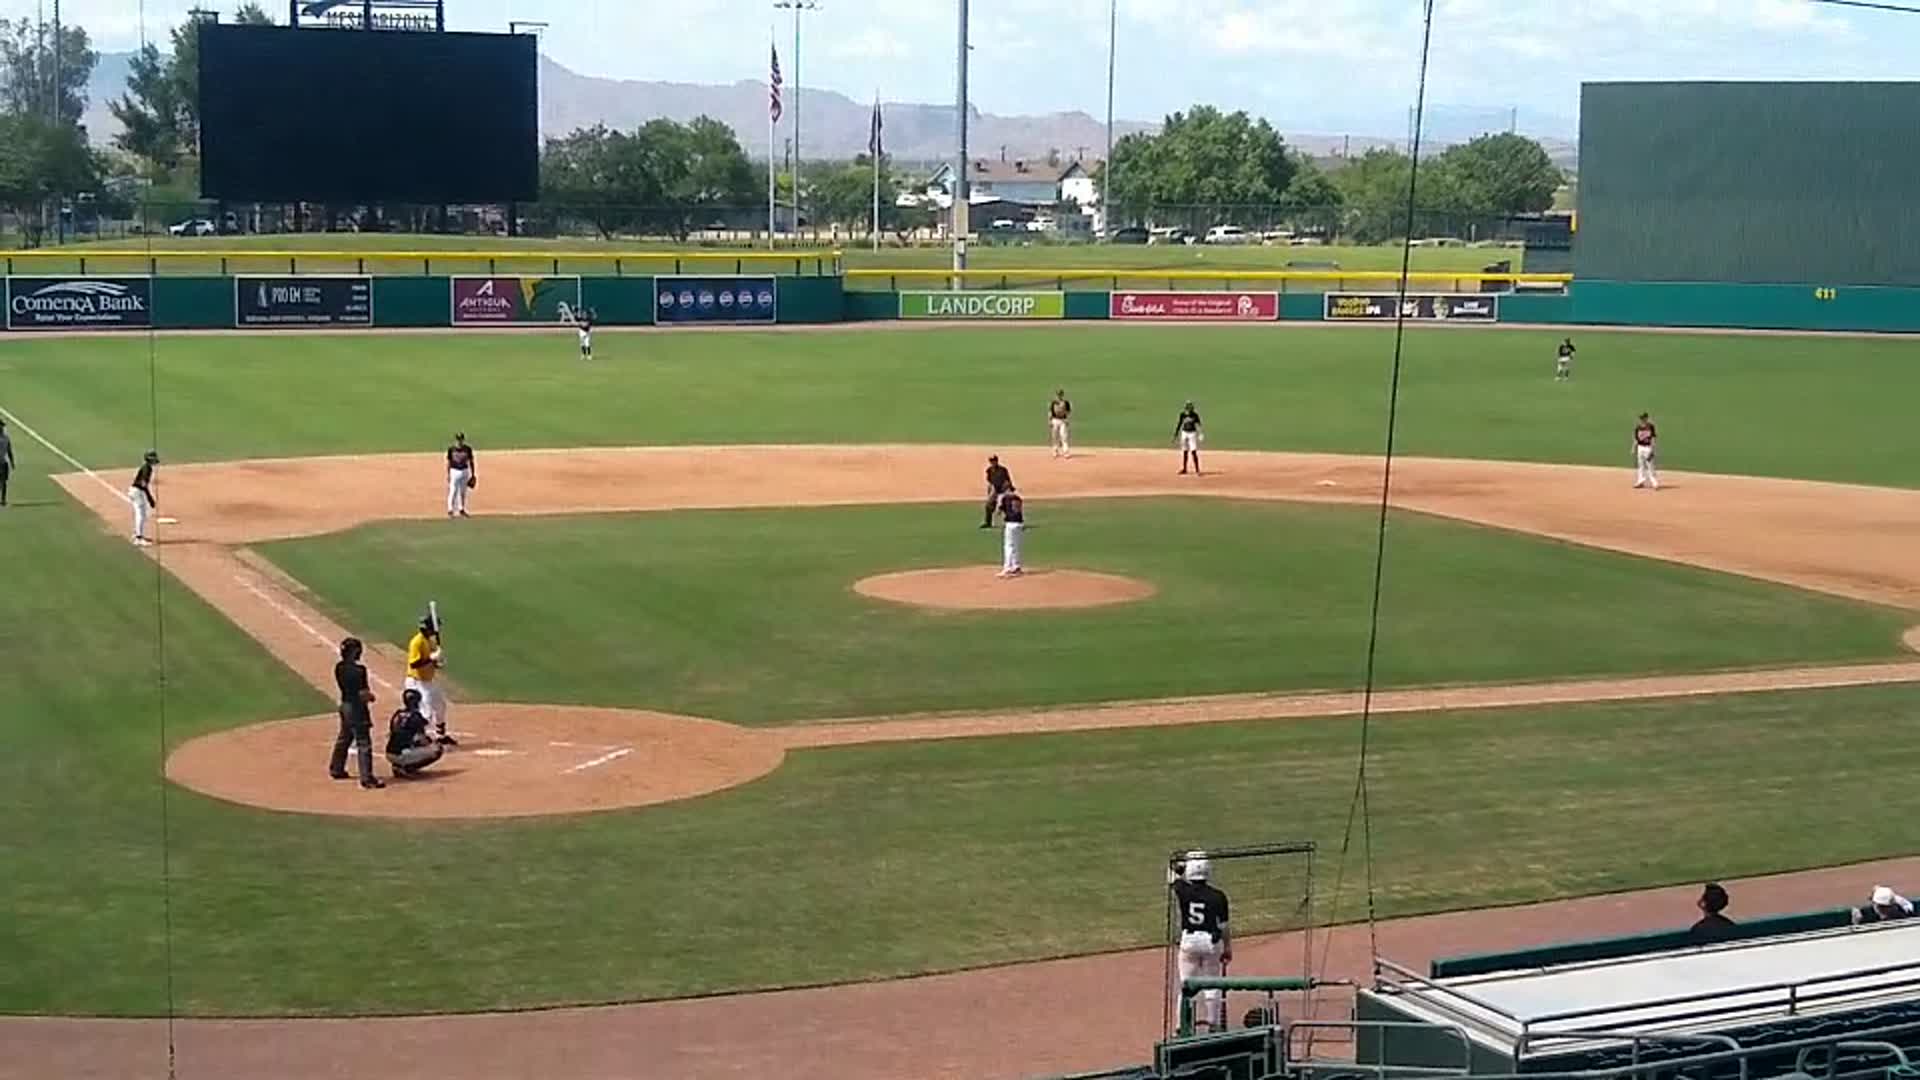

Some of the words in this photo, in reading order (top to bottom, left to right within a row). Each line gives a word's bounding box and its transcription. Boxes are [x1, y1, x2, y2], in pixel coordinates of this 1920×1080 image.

[99, 295, 144, 311] Bank
[459, 297, 511, 308] ANTIGUA
[927, 295, 1035, 315] LANDCORP
[1189, 902, 1206, 924] 5
